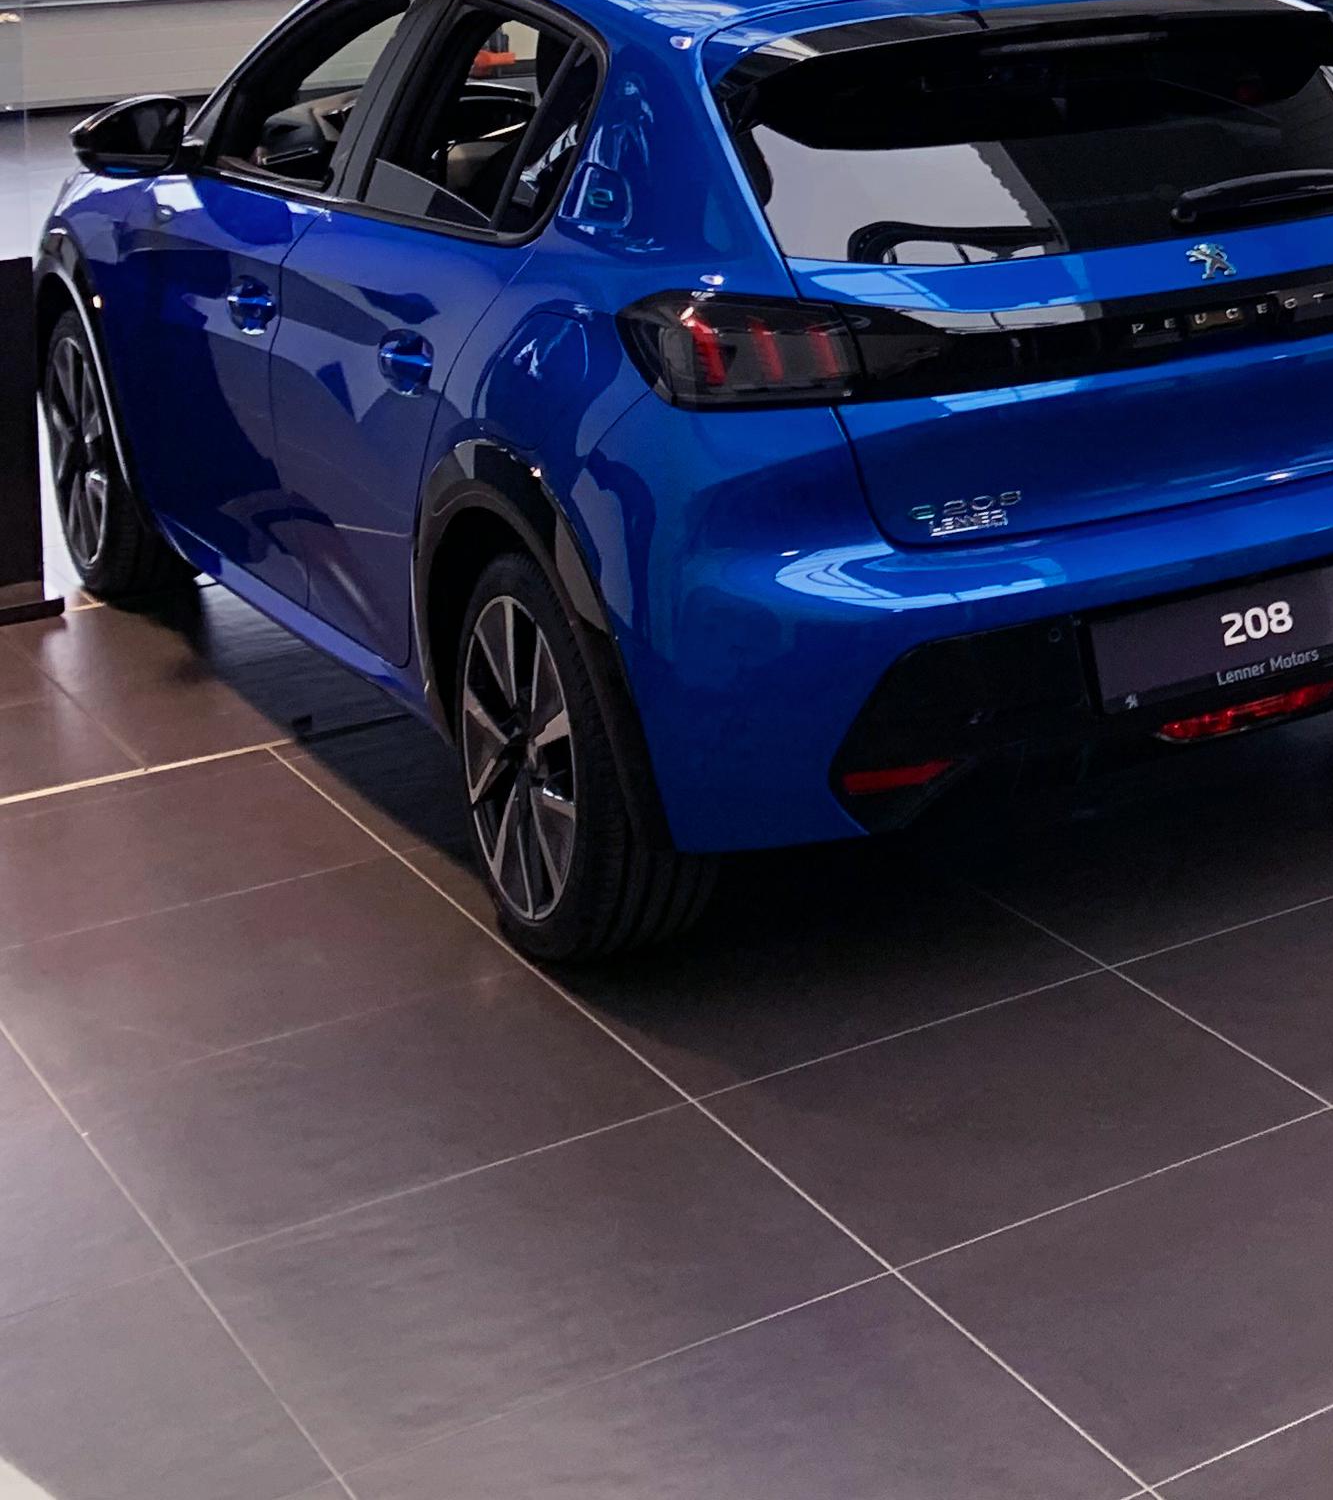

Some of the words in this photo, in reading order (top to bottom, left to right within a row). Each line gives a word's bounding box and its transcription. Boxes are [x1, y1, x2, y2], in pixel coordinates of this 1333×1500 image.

[1220, 600, 1294, 647] 208
[1216, 661, 1267, 687] Lenner
[1269, 649, 1320, 672] Motors
